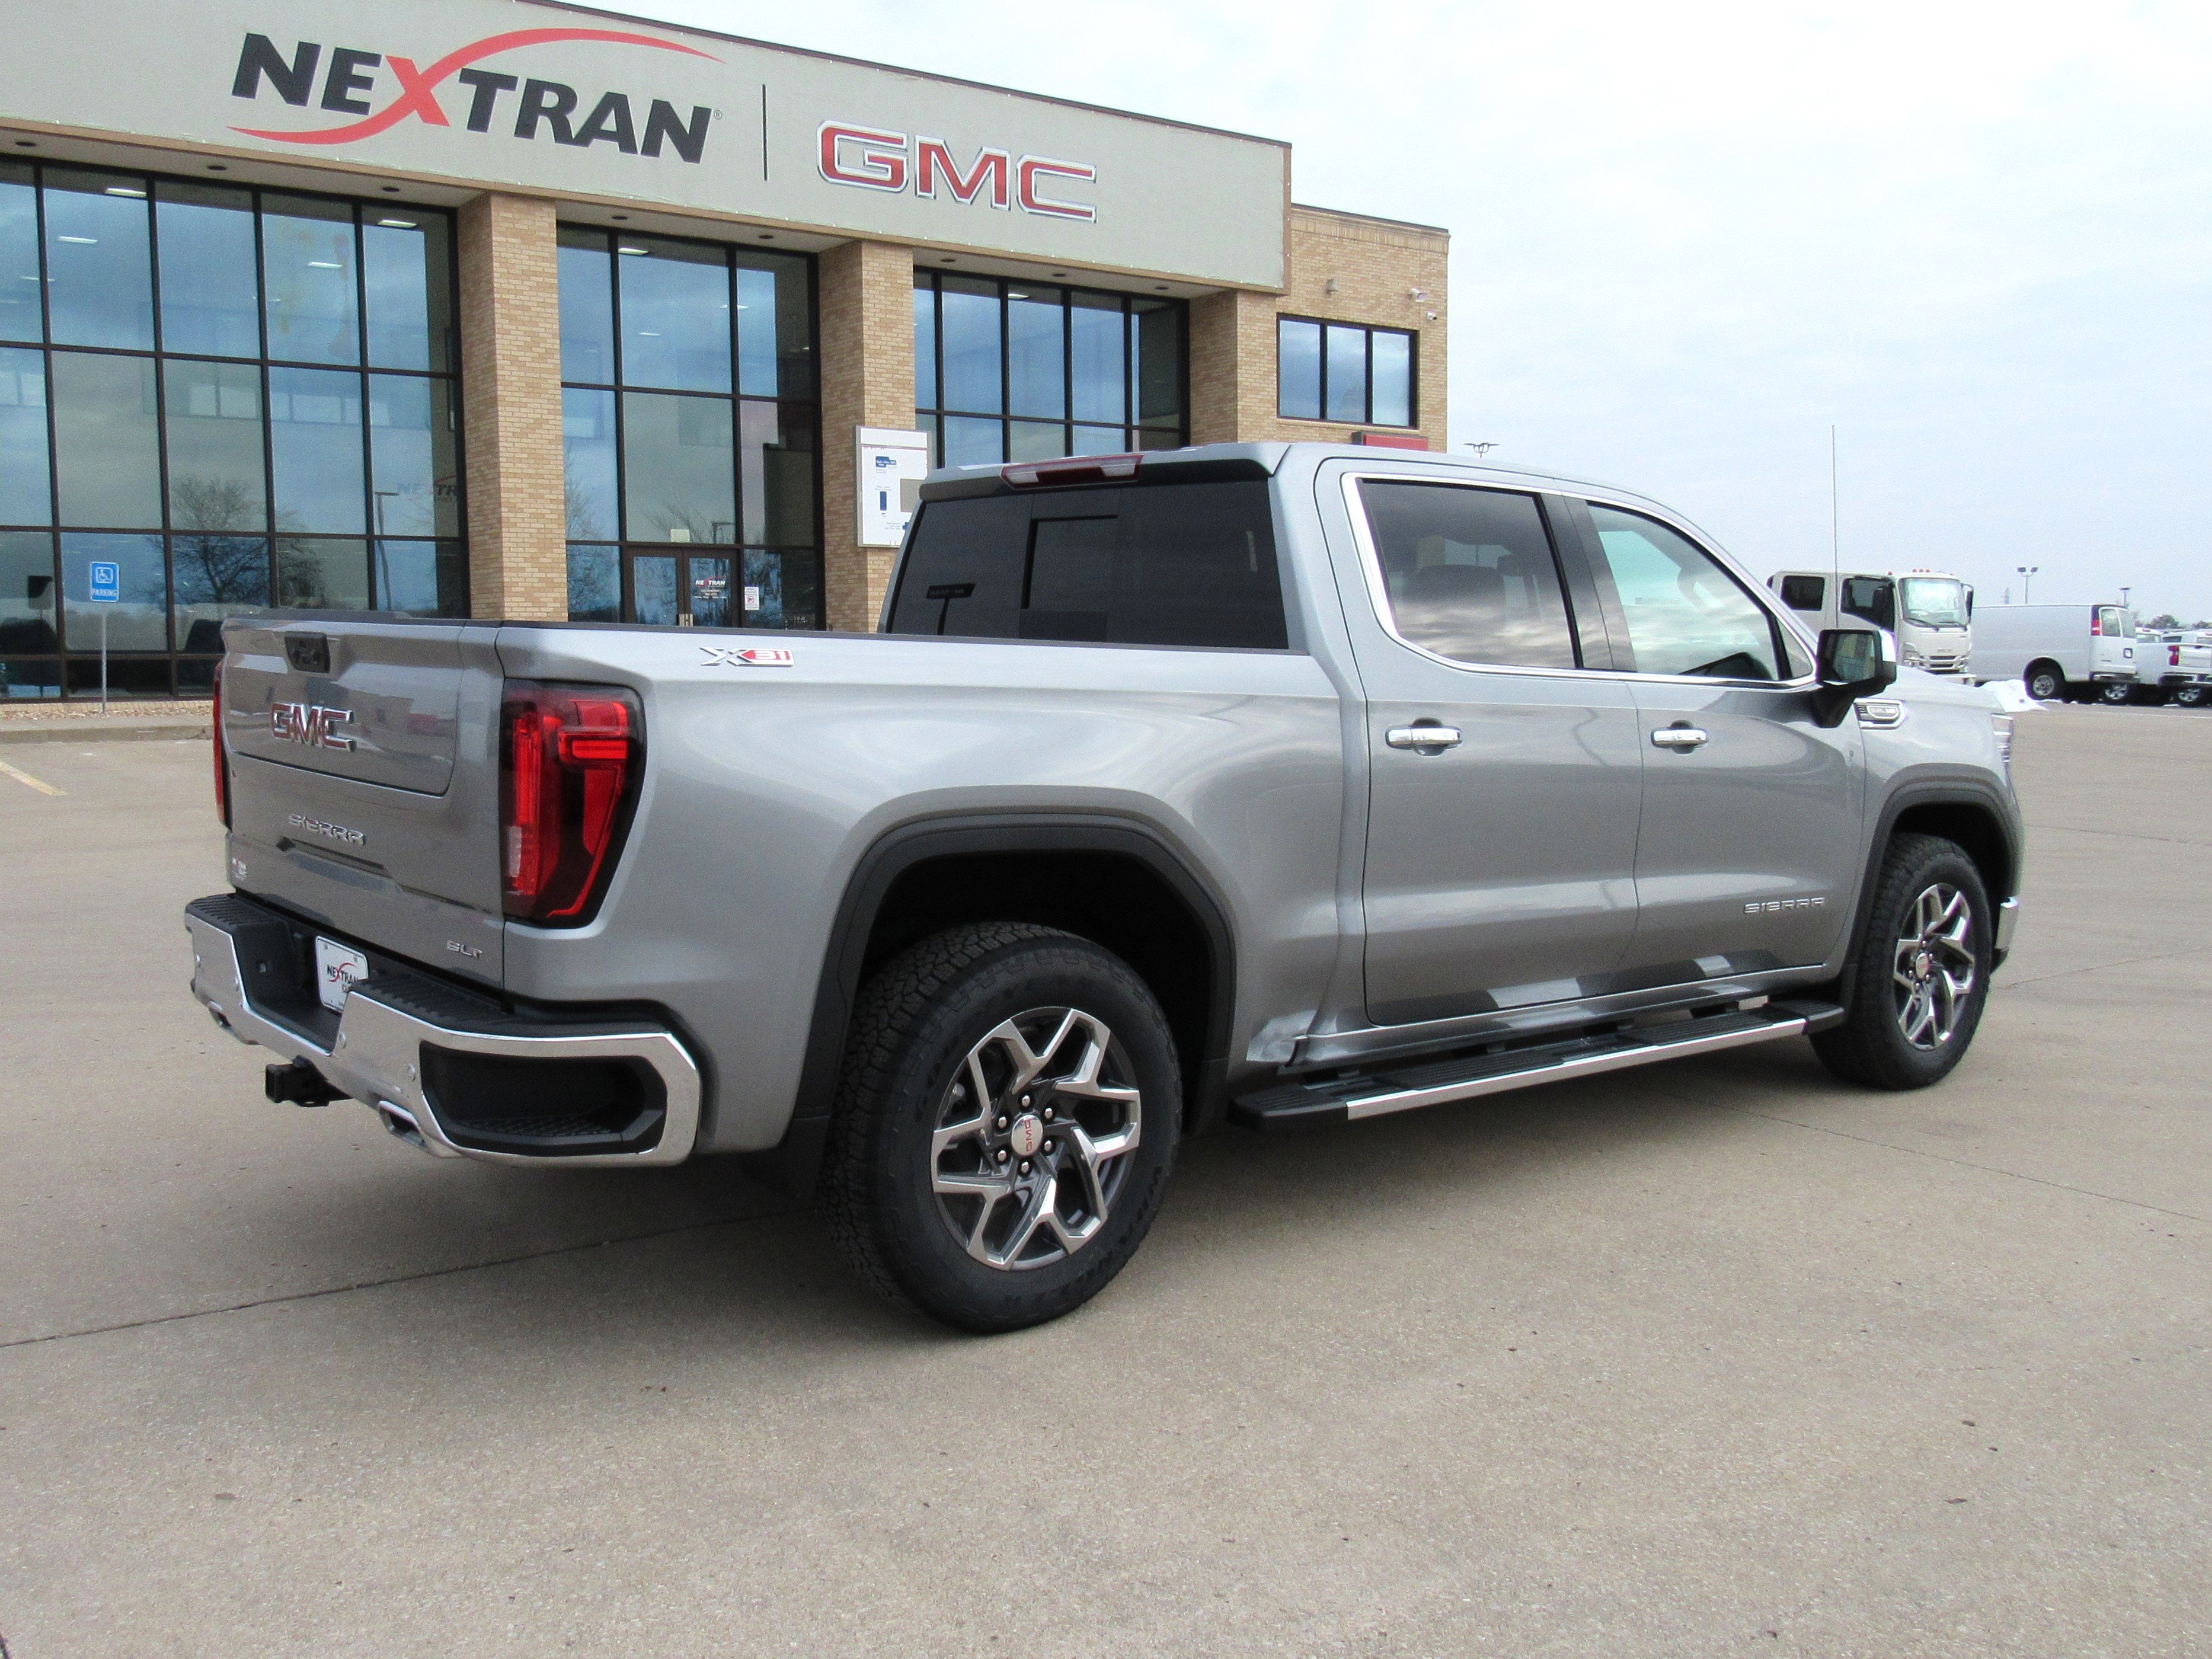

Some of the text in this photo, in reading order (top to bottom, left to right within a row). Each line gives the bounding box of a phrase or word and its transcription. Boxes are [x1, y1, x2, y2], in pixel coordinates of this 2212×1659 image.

[232, 32, 712, 165] NEXTRAN
[817, 120, 1097, 224] GMC
[699, 645, 795, 667] X31
[271, 702, 356, 753] GMC
[289, 813, 365, 846] SIERRA
[1744, 897, 1826, 914] SIERRA
[446, 941, 484, 958] SLT
[1023, 1116, 1034, 1152] GMC
